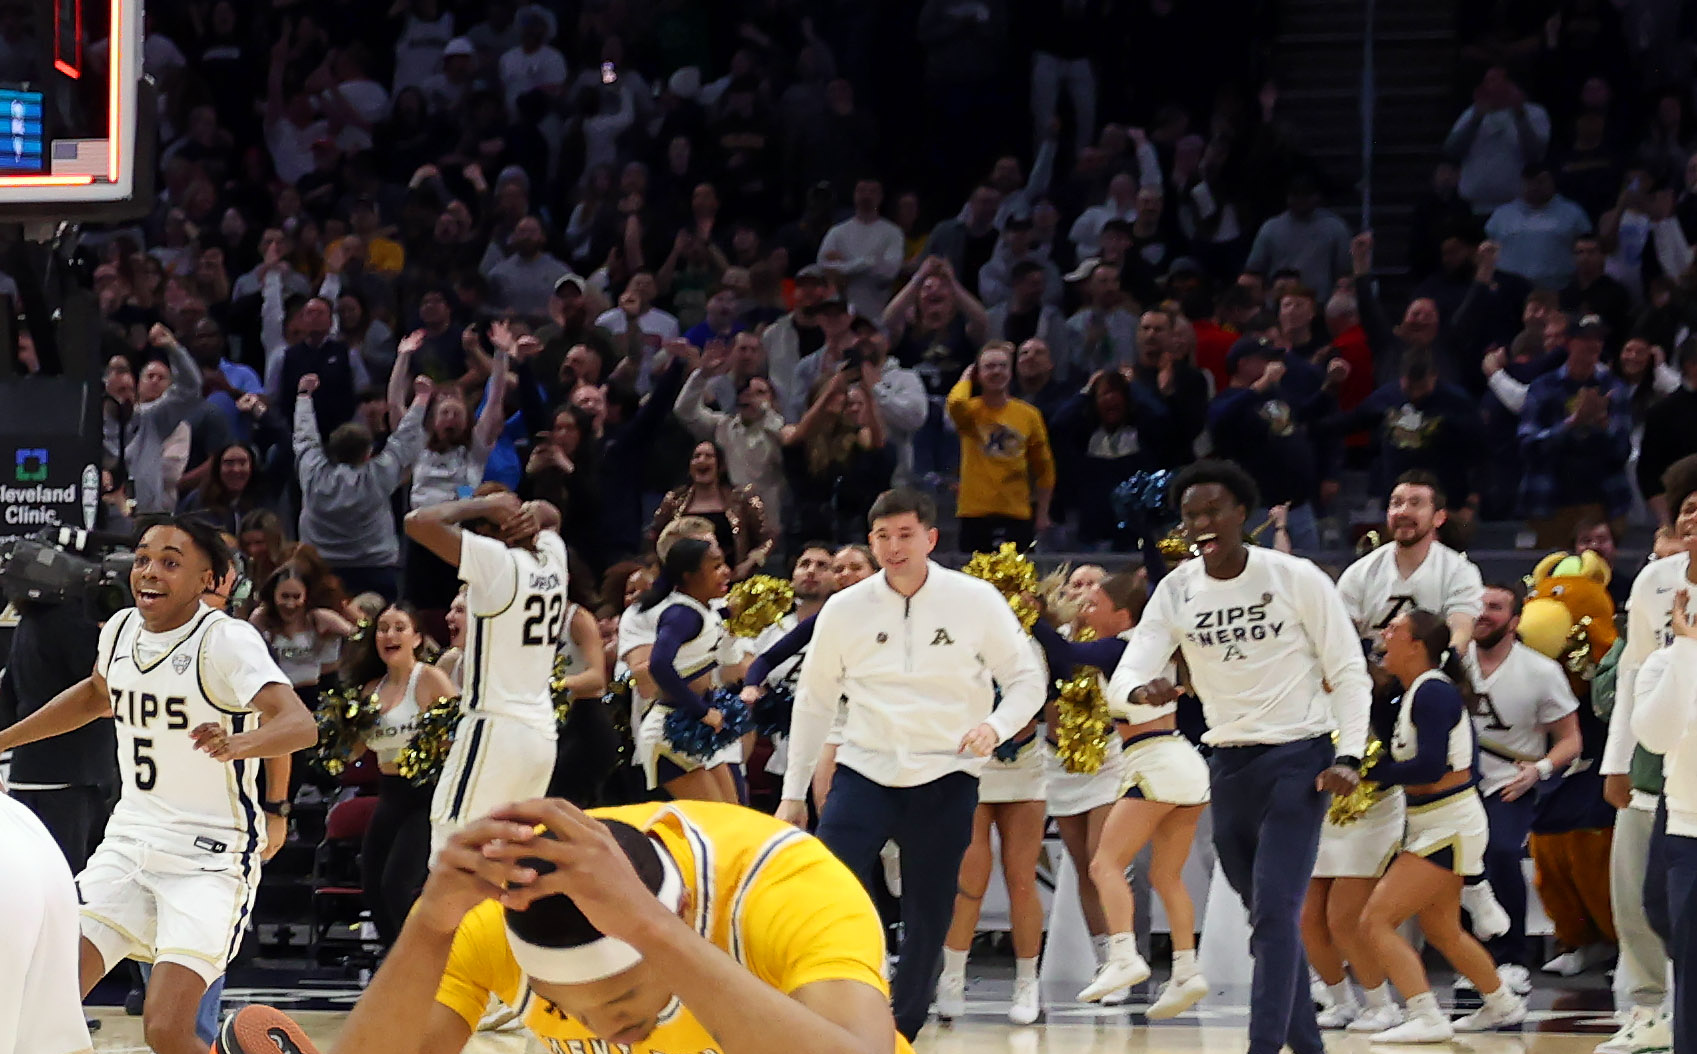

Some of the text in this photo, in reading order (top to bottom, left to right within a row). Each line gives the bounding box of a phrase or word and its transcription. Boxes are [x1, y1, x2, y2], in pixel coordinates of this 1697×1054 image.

[4, 504, 57, 525] Clinic
[522, 593, 563, 646] 22
[1194, 603, 1267, 629] ZIPS
[929, 628, 955, 646] A
[110, 686, 190, 731] ZIPS
[132, 735, 158, 792] 5
